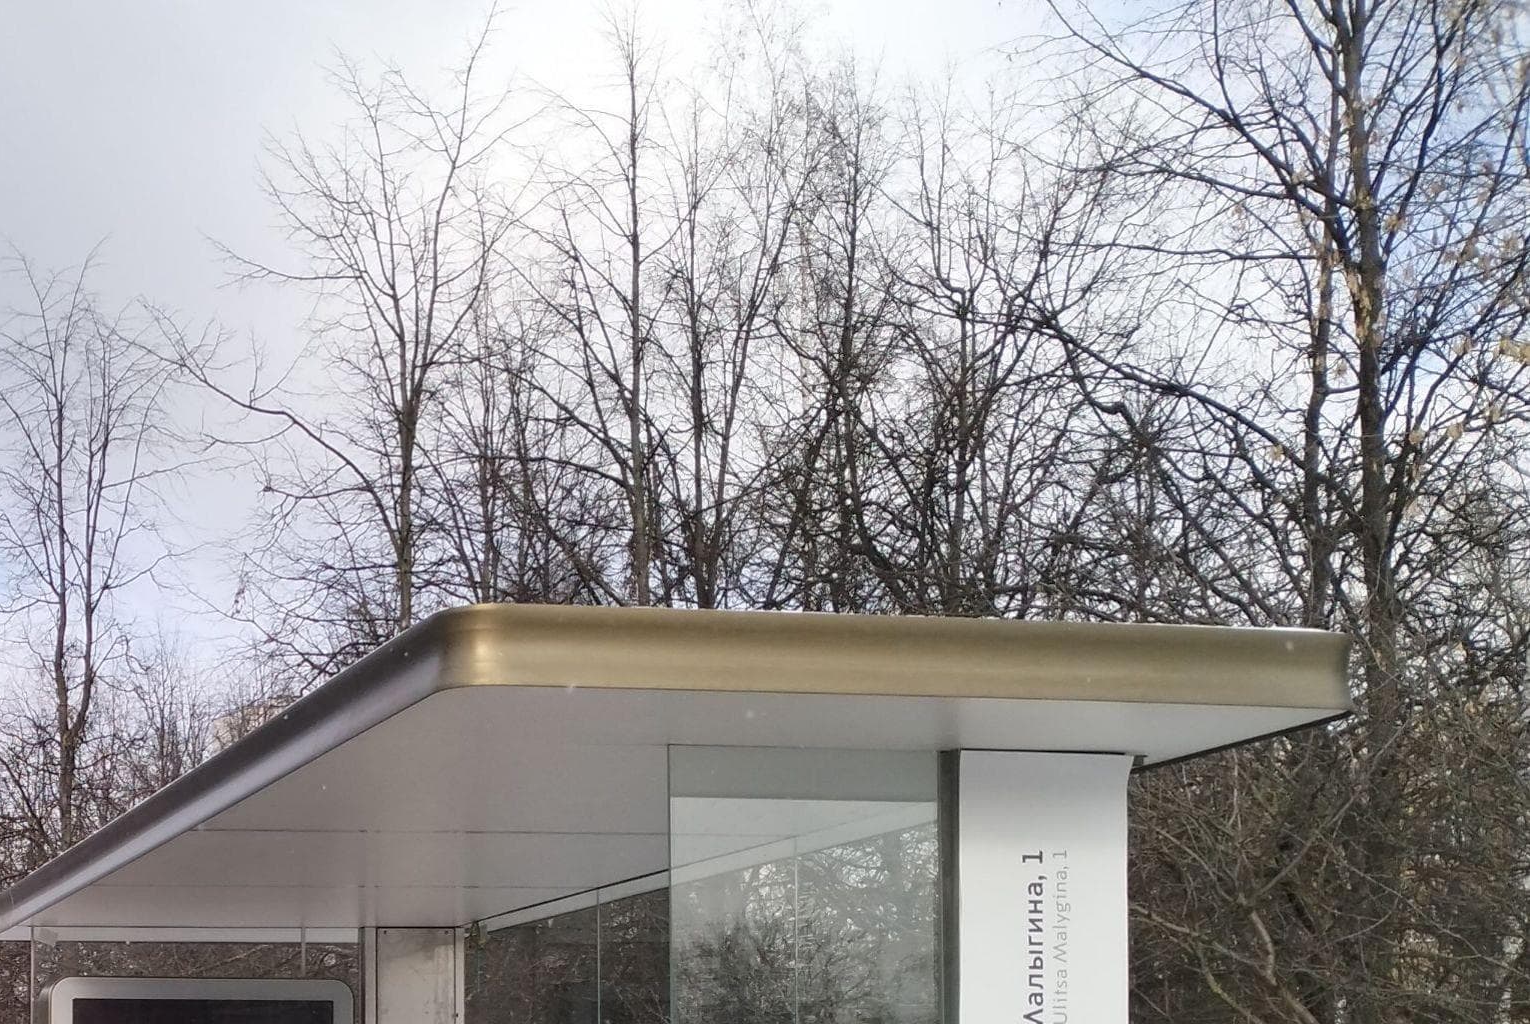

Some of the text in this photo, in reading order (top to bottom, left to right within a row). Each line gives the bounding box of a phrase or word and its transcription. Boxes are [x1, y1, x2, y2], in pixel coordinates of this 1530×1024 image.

[1022, 850, 1043, 864] 1
[1052, 849, 1068, 860] 1
[1052, 865, 1071, 963] Malygina,
